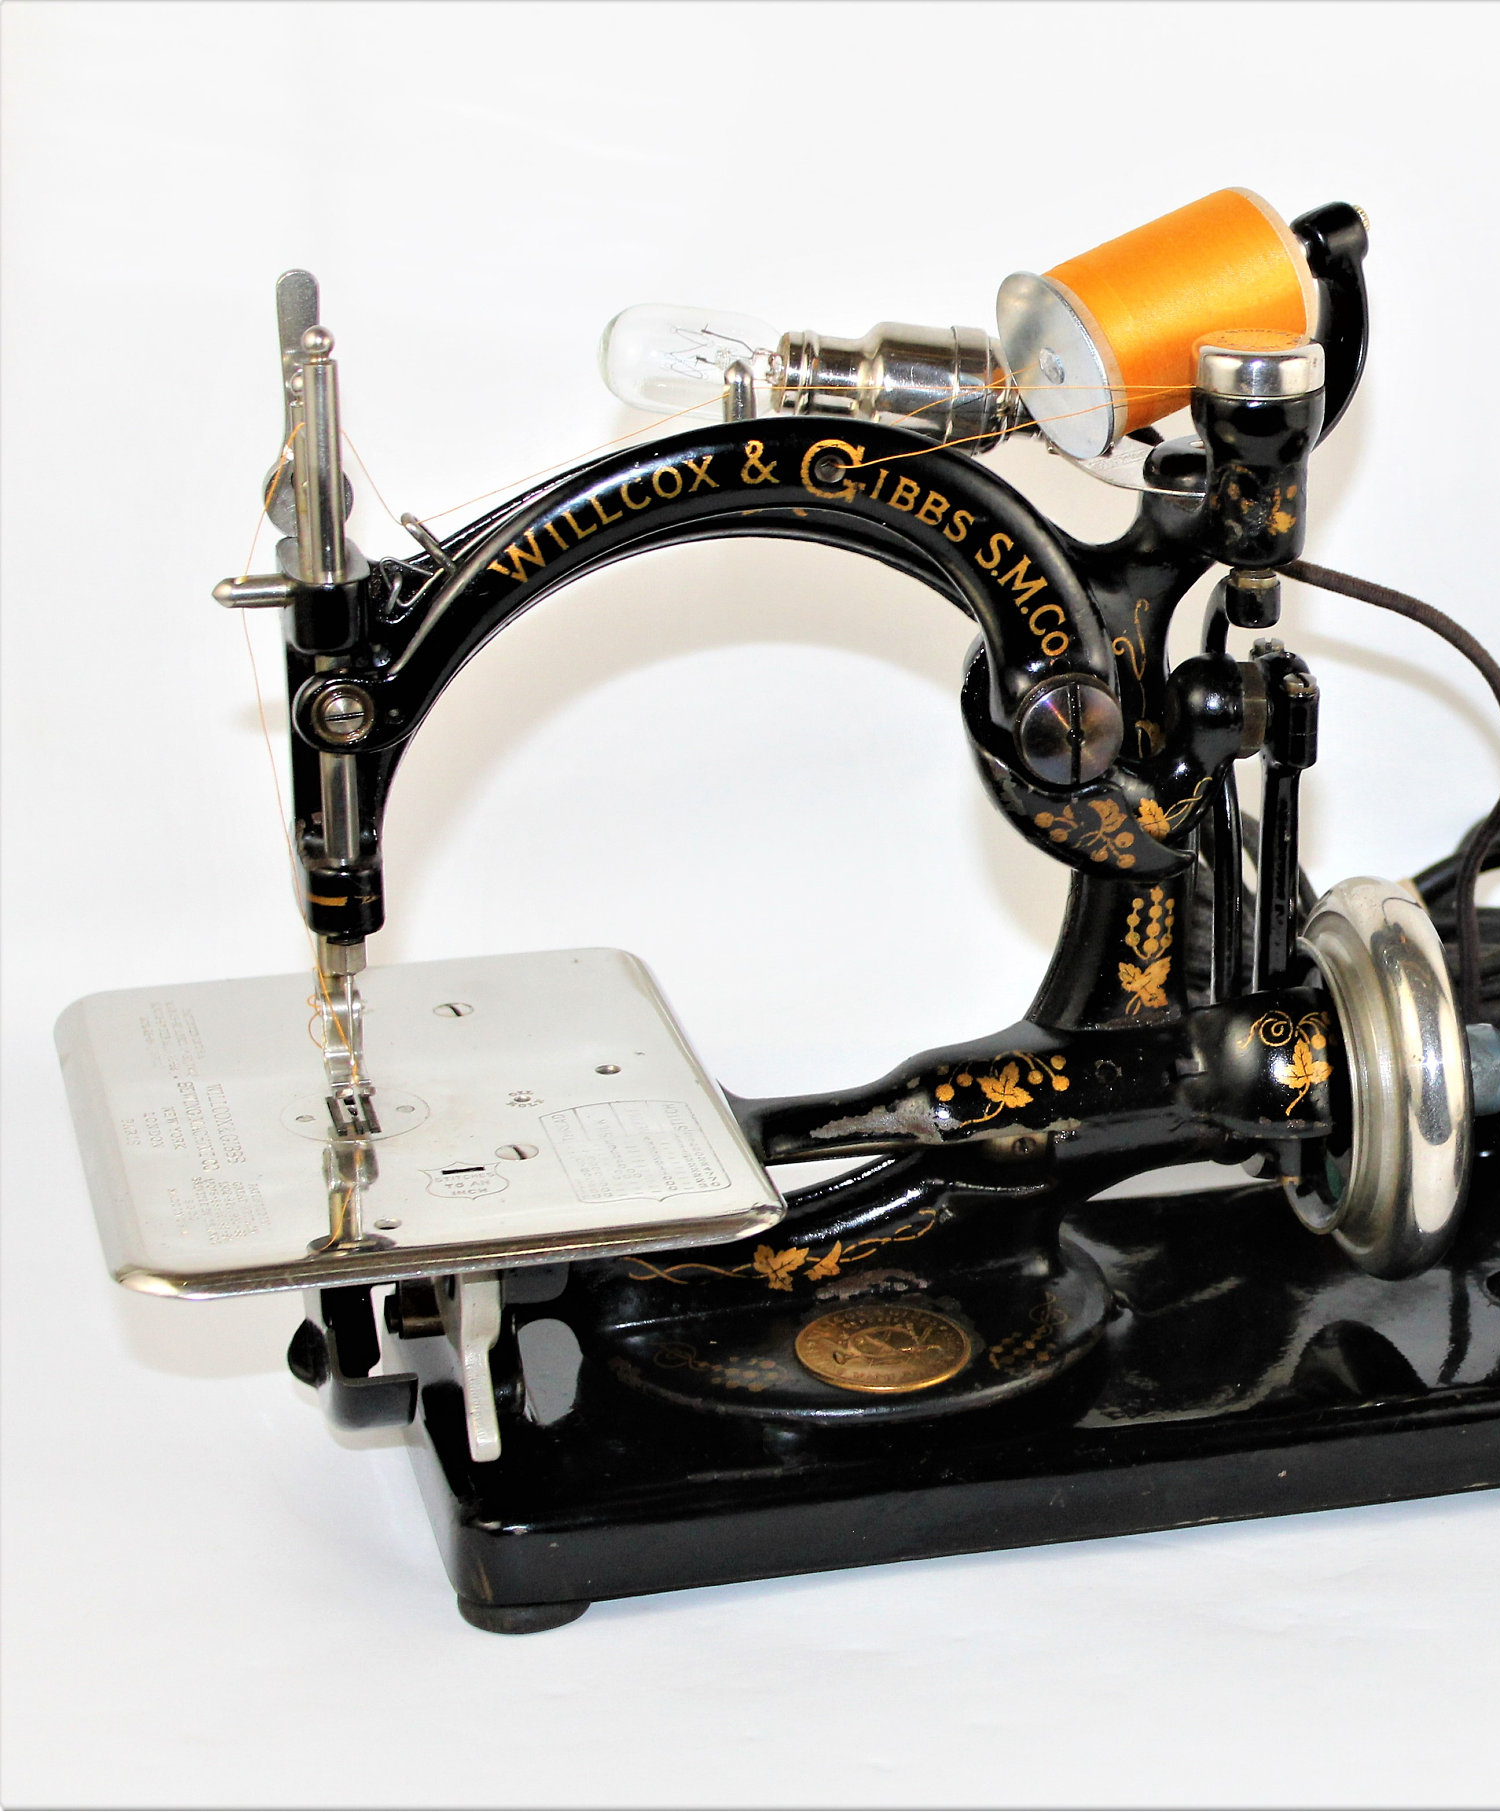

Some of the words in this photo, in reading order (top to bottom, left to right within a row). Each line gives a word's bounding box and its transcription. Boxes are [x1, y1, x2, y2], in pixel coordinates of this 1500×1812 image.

[487, 455, 721, 584] WILLCOX
[740, 440, 781, 485] &
[800, 439, 982, 543] GIBBS
